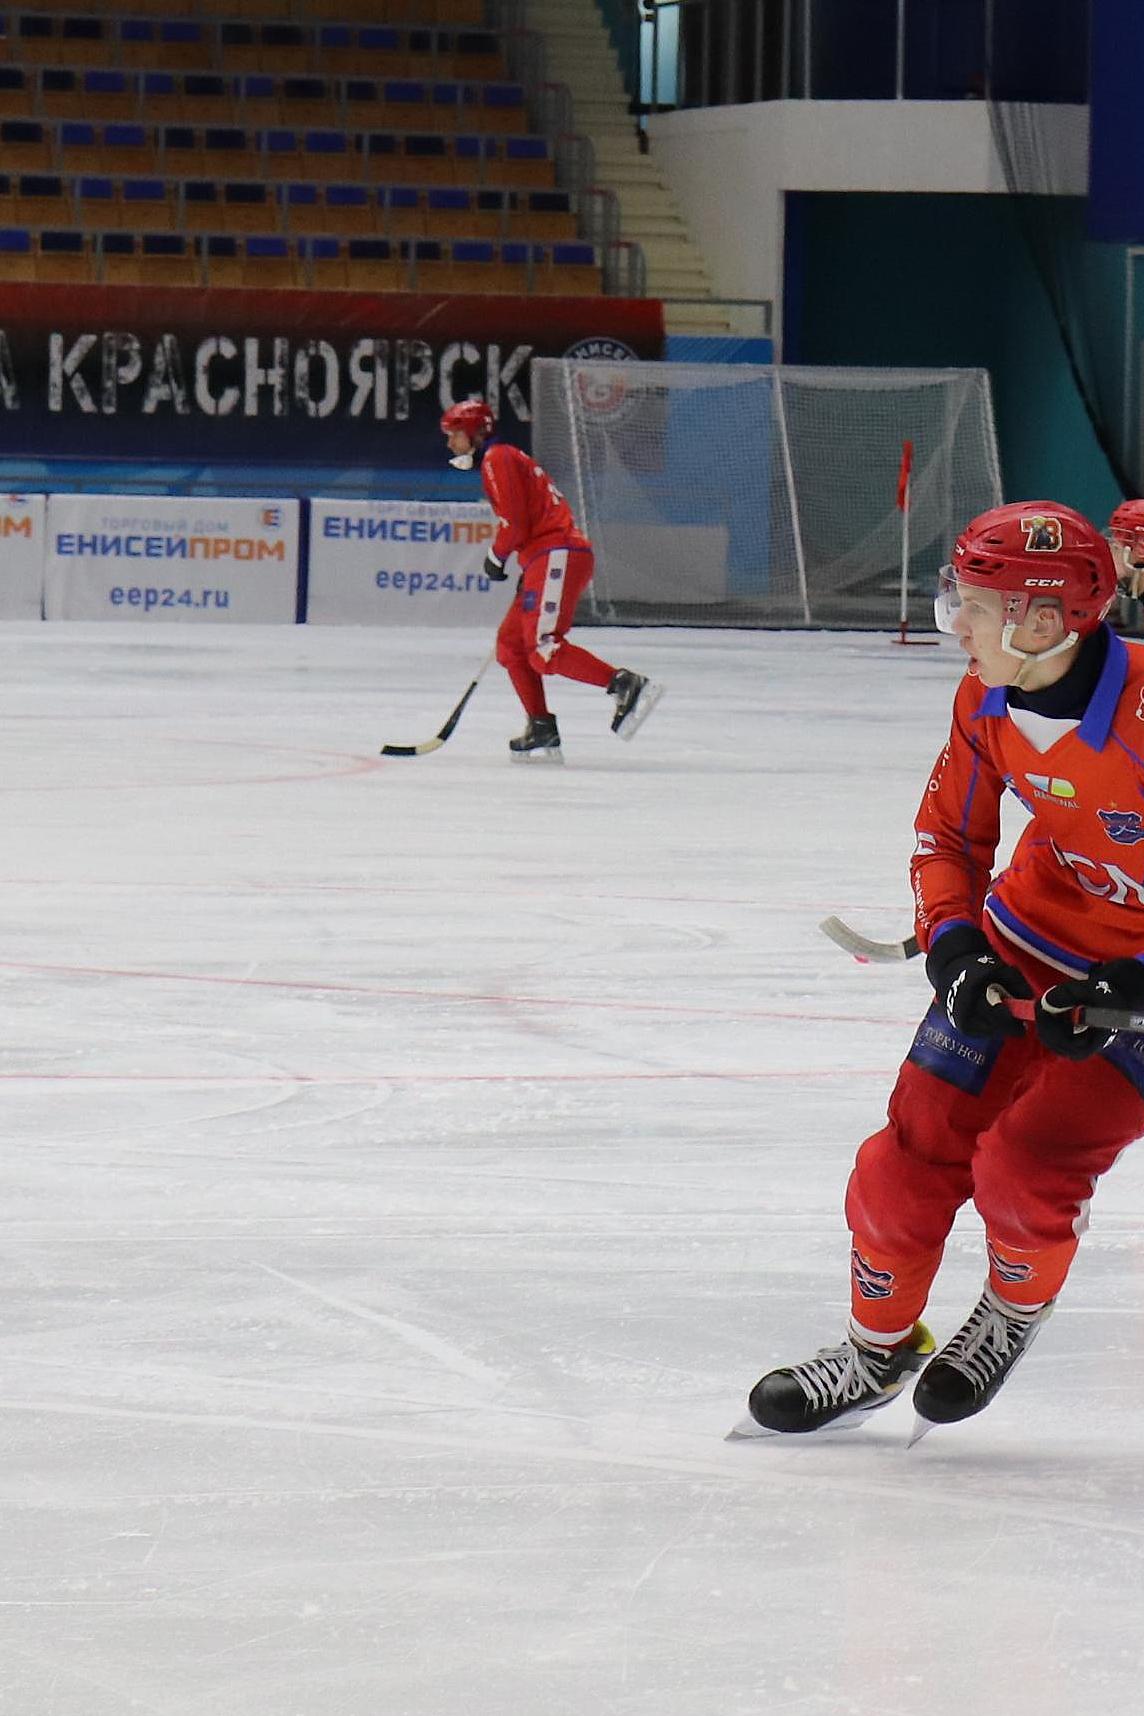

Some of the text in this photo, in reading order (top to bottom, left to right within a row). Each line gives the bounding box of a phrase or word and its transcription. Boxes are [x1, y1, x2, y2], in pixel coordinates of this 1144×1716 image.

[48, 331, 534, 422] КРАСНОЯРСК
[56, 531, 286, 561] ЕНИСЕЙПРОМ
[375, 570, 492, 596] eep24.ru
[1024, 579, 1065, 587] CCM
[109, 586, 230, 611] eep24.ru
